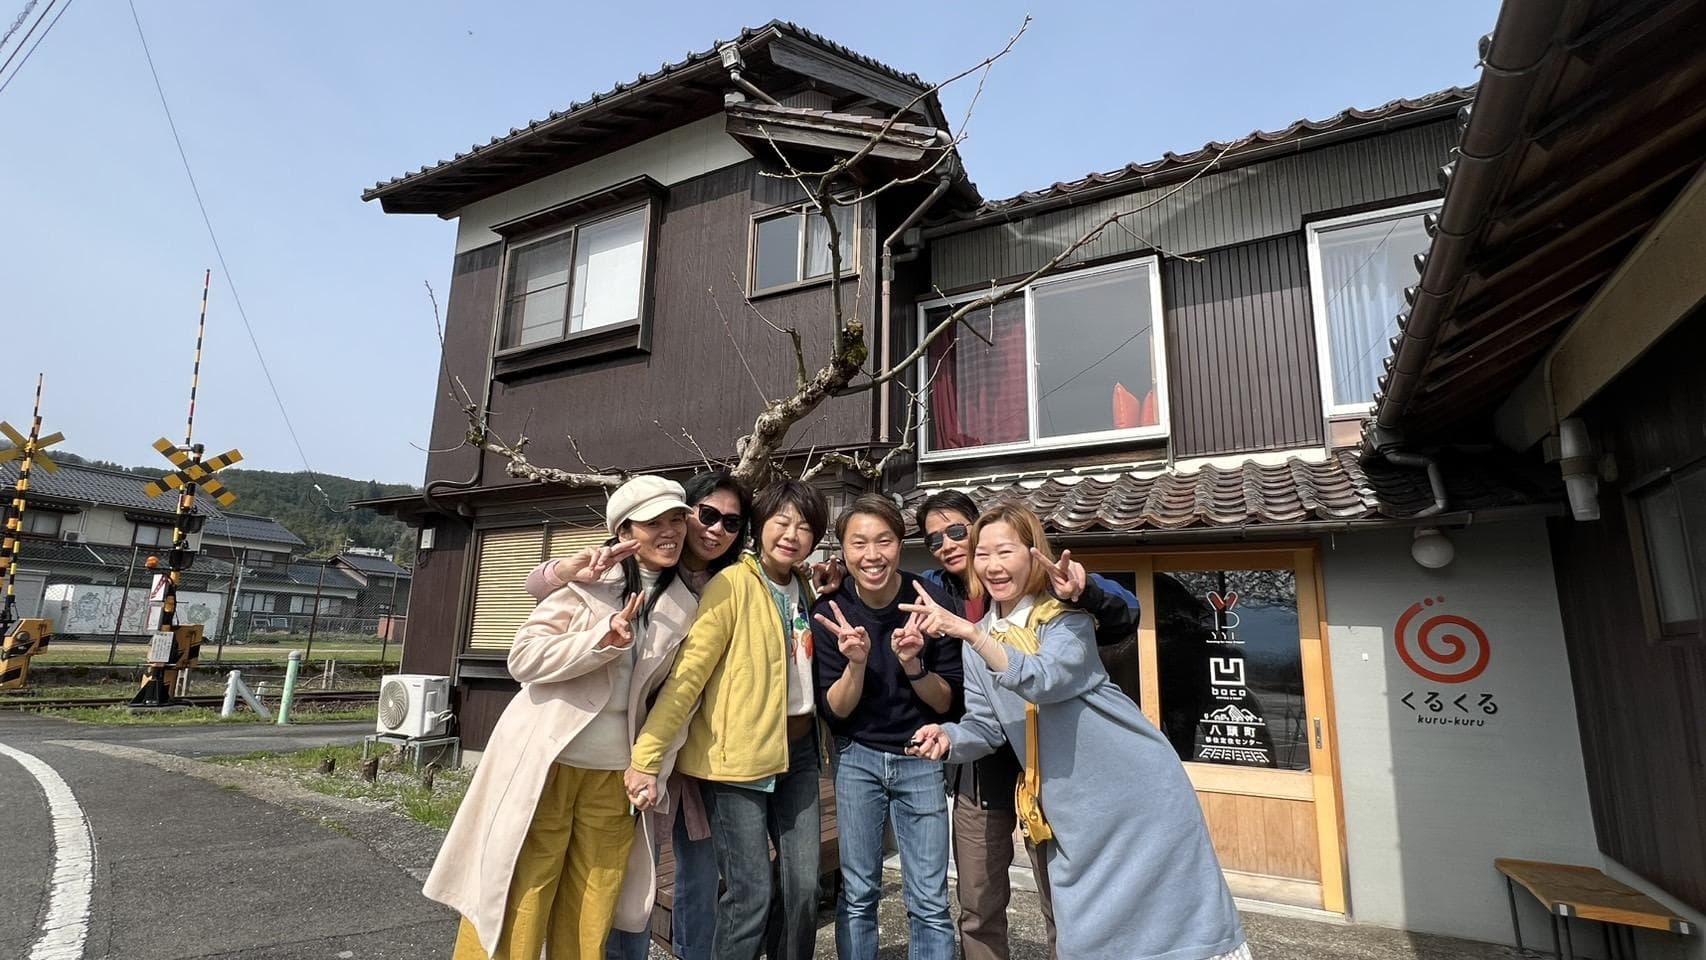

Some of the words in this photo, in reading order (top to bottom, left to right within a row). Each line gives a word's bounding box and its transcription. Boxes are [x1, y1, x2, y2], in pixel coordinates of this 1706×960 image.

[1401, 691, 1498, 715] くるくる
[1417, 714, 1485, 727] kuru-kuru
